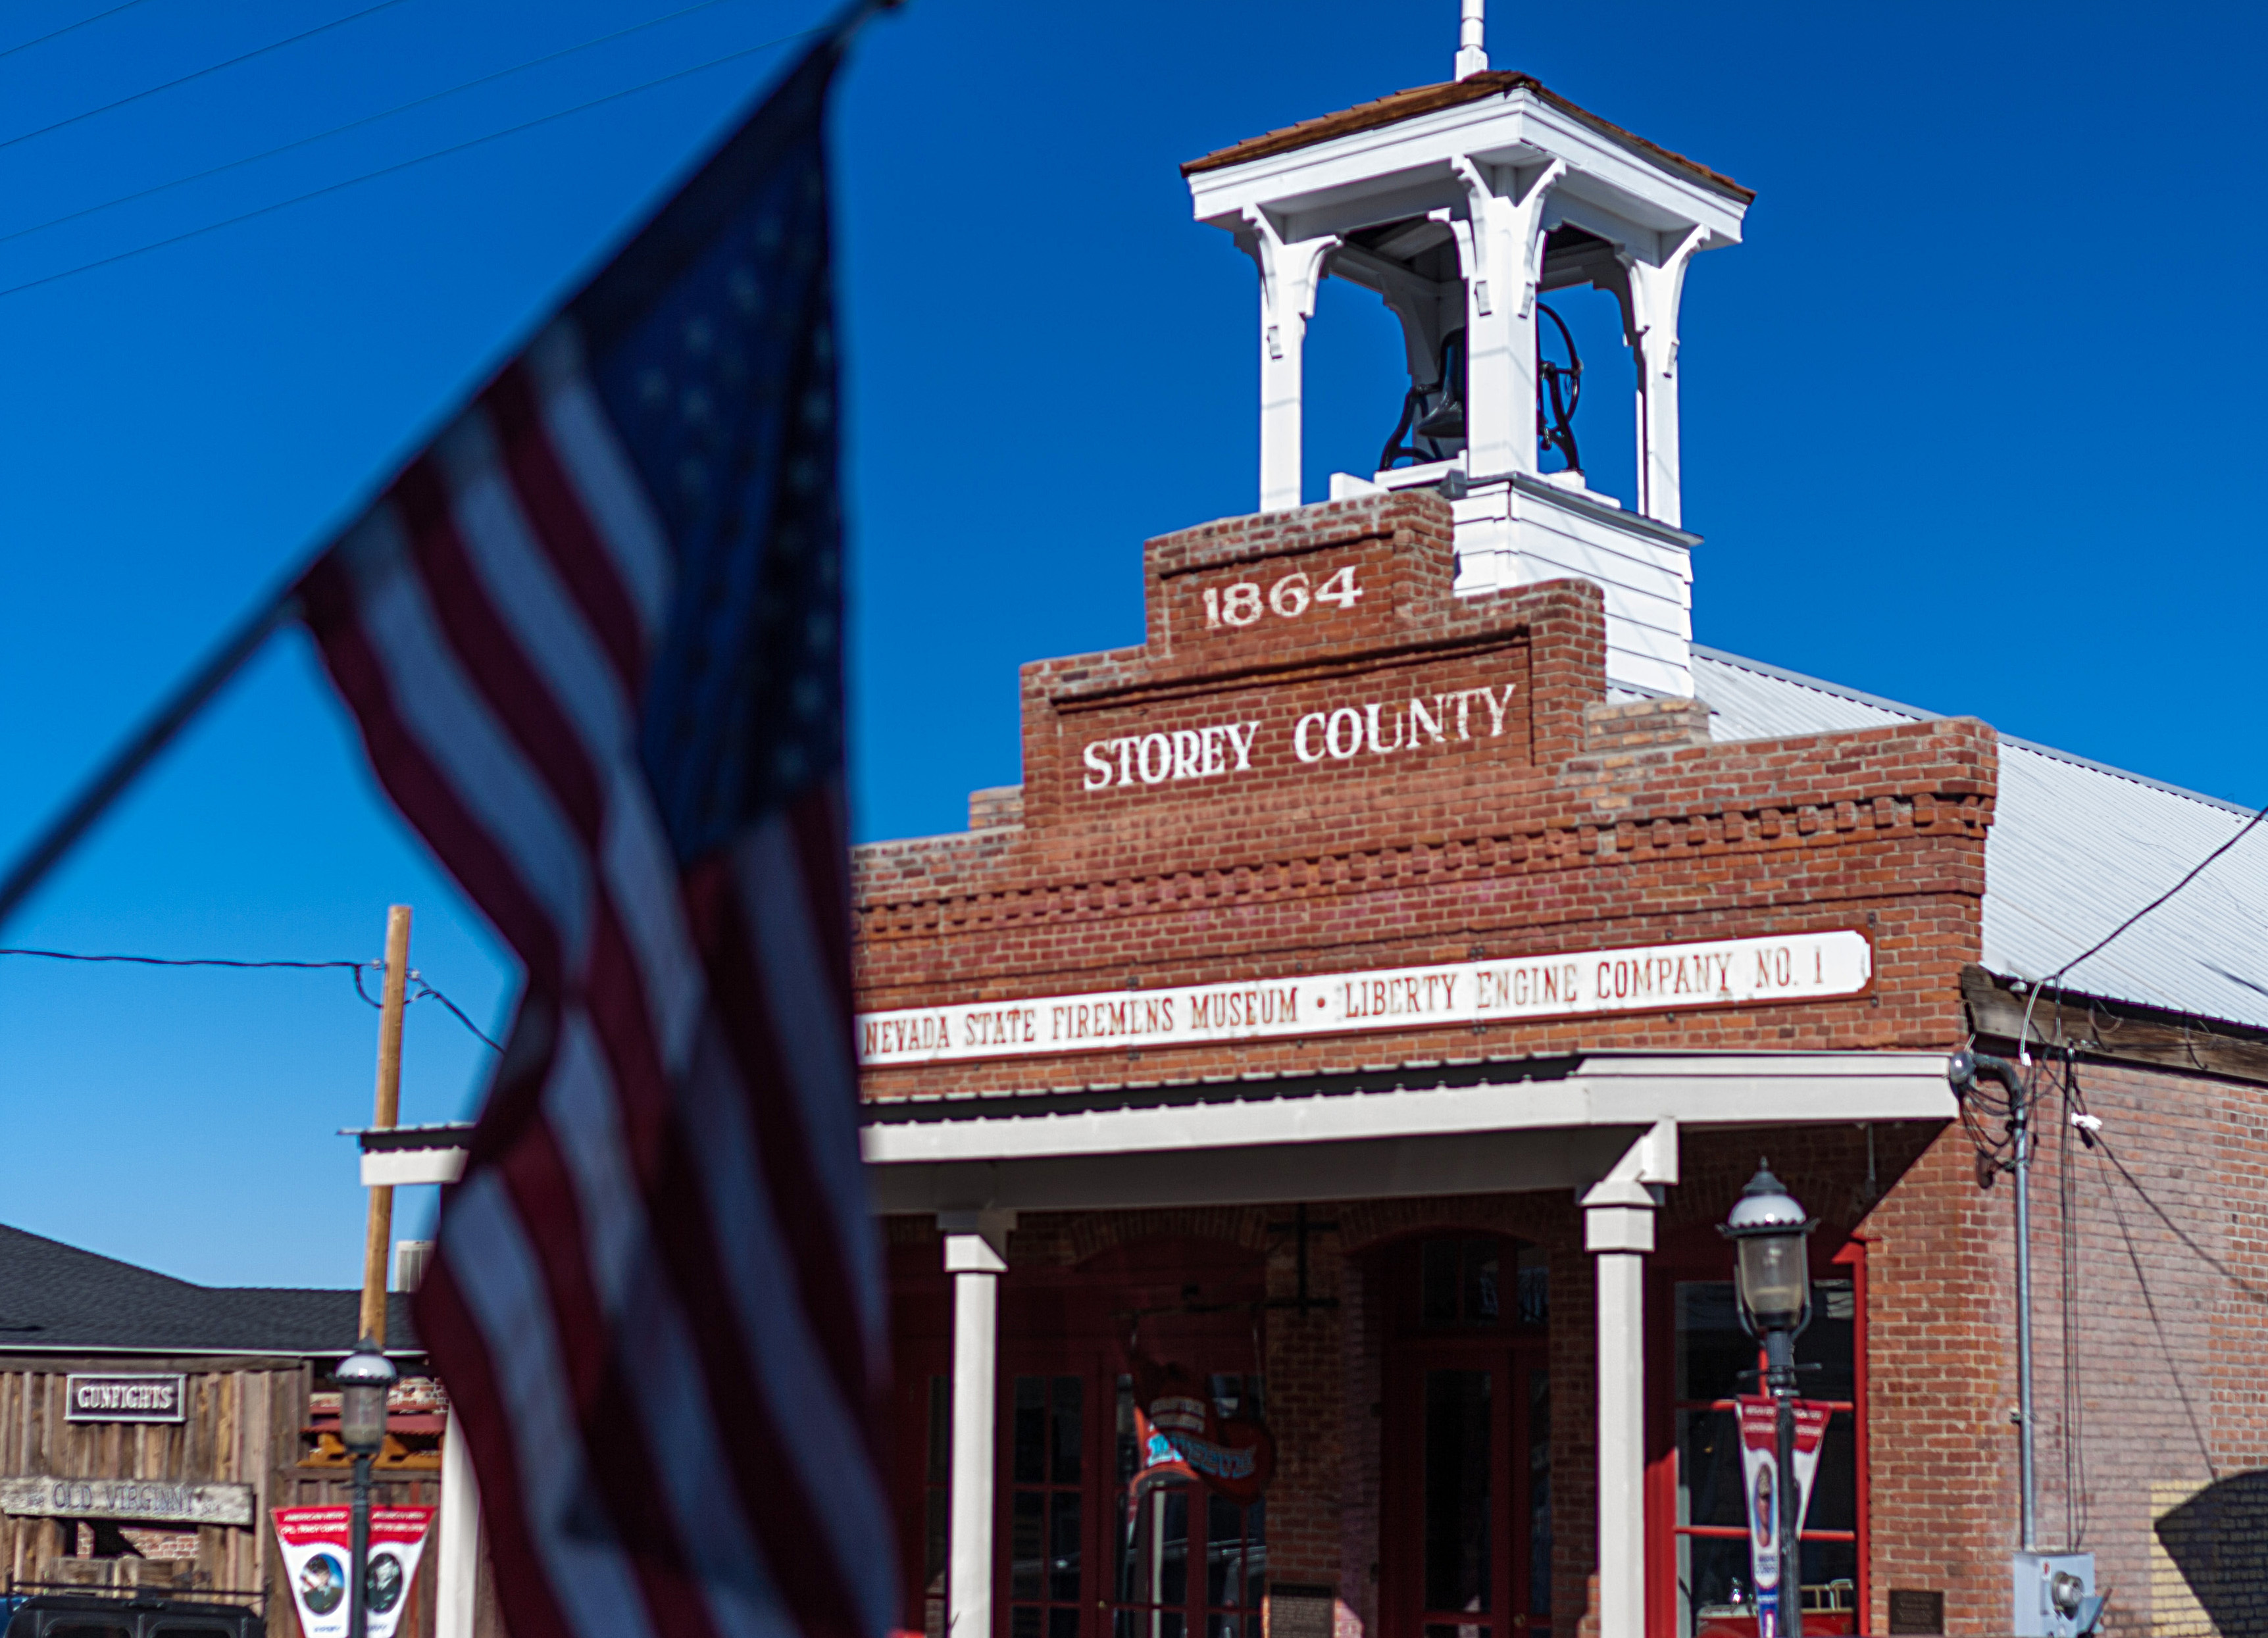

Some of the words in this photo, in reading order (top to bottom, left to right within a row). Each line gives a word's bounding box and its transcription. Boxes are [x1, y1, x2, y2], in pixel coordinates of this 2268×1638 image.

[1203, 566, 1363, 630] 1864
[1082, 721, 1261, 791] STOREY
[1294, 684, 1516, 763] COUNTY
[865, 1016, 950, 1056] NEVADA
[966, 1009, 1036, 1047] STATE
[1191, 987, 1298, 1030] MUSEUM
[1346, 972, 1457, 1018] LIBERTY
[1477, 964, 1577, 1009] ENGINE
[1597, 952, 1740, 1000] COMPANY
[78, 1385, 174, 1410] GUNFIGHTS
[51, 1483, 92, 1510] OLD
